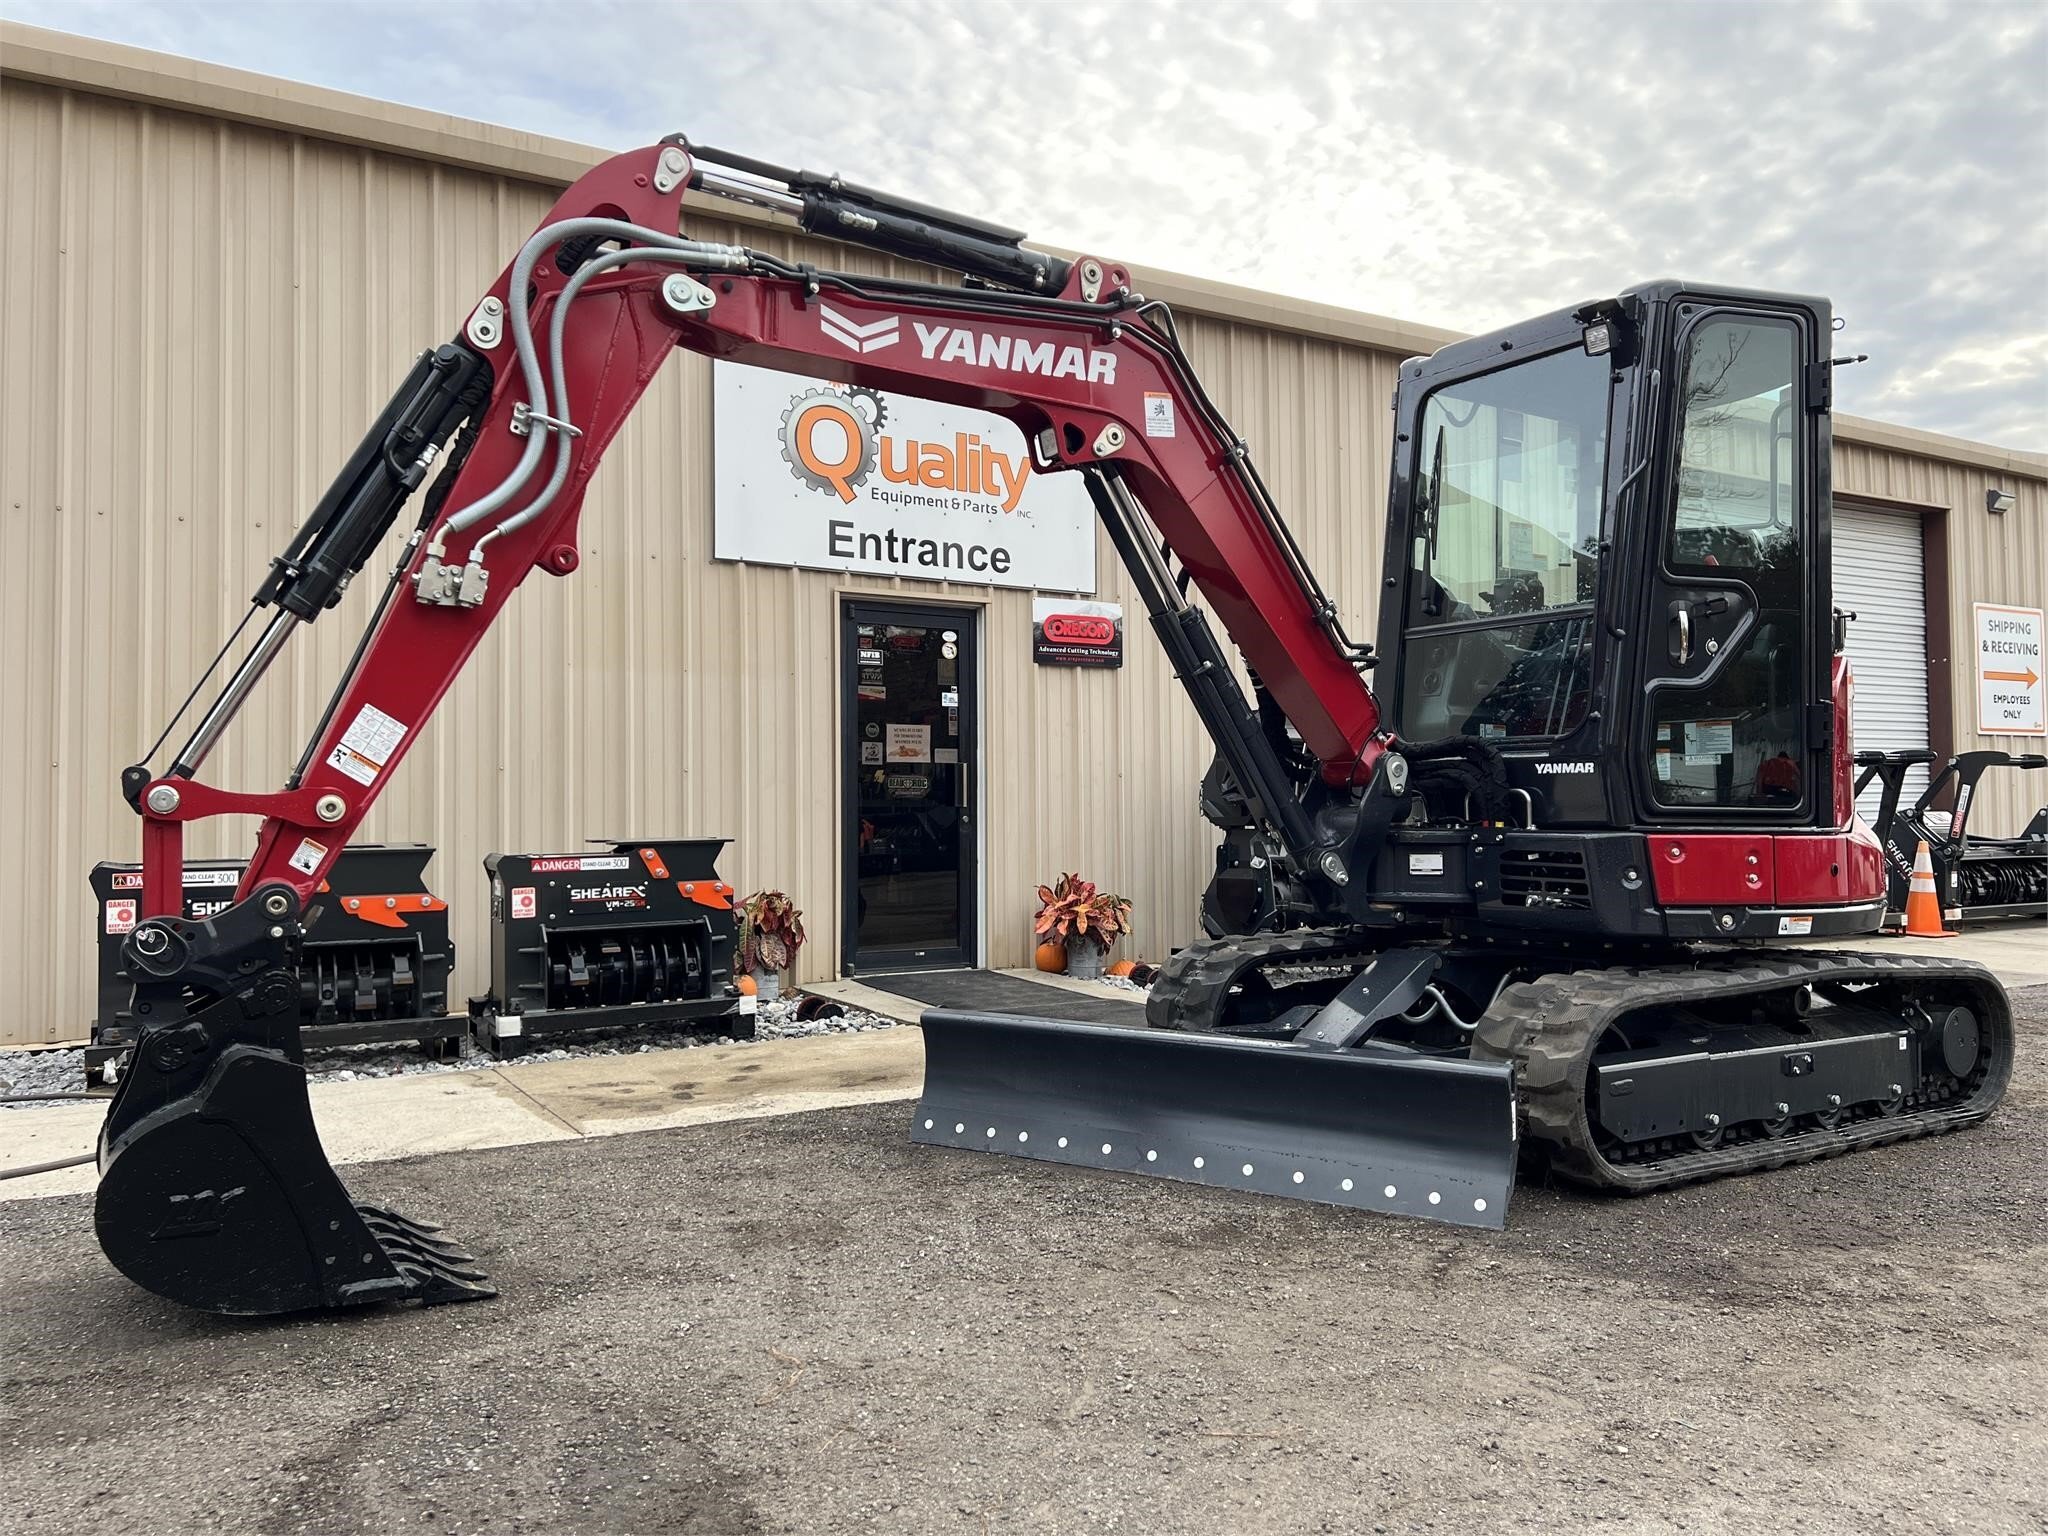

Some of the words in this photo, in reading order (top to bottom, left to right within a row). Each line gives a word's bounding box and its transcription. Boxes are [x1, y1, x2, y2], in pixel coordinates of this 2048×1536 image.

[912, 321, 1118, 385] YANMAR
[795, 404, 1031, 514] Quality
[871, 487, 948, 509] Equipment
[951, 498, 961, 510] &
[963, 499, 998, 515] Parts
[828, 519, 1012, 574] Entrance
[1053, 621, 1107, 638] OREGON
[1988, 619, 2032, 635] SHIPPING
[1067, 647, 1089, 655] Cutting
[1089, 648, 1119, 657] Technology
[1982, 640, 1989, 652] &
[1991, 640, 2039, 656] RECEIVING
[1993, 694, 2031, 705] EMPLOYEES
[2003, 709, 2022, 719] ONLY
[1534, 762, 1595, 775] YANMAR
[541, 860, 580, 871] DANGER
[1886, 839, 1914, 877] SHEAR
[570, 885, 646, 900] SHEAREX
